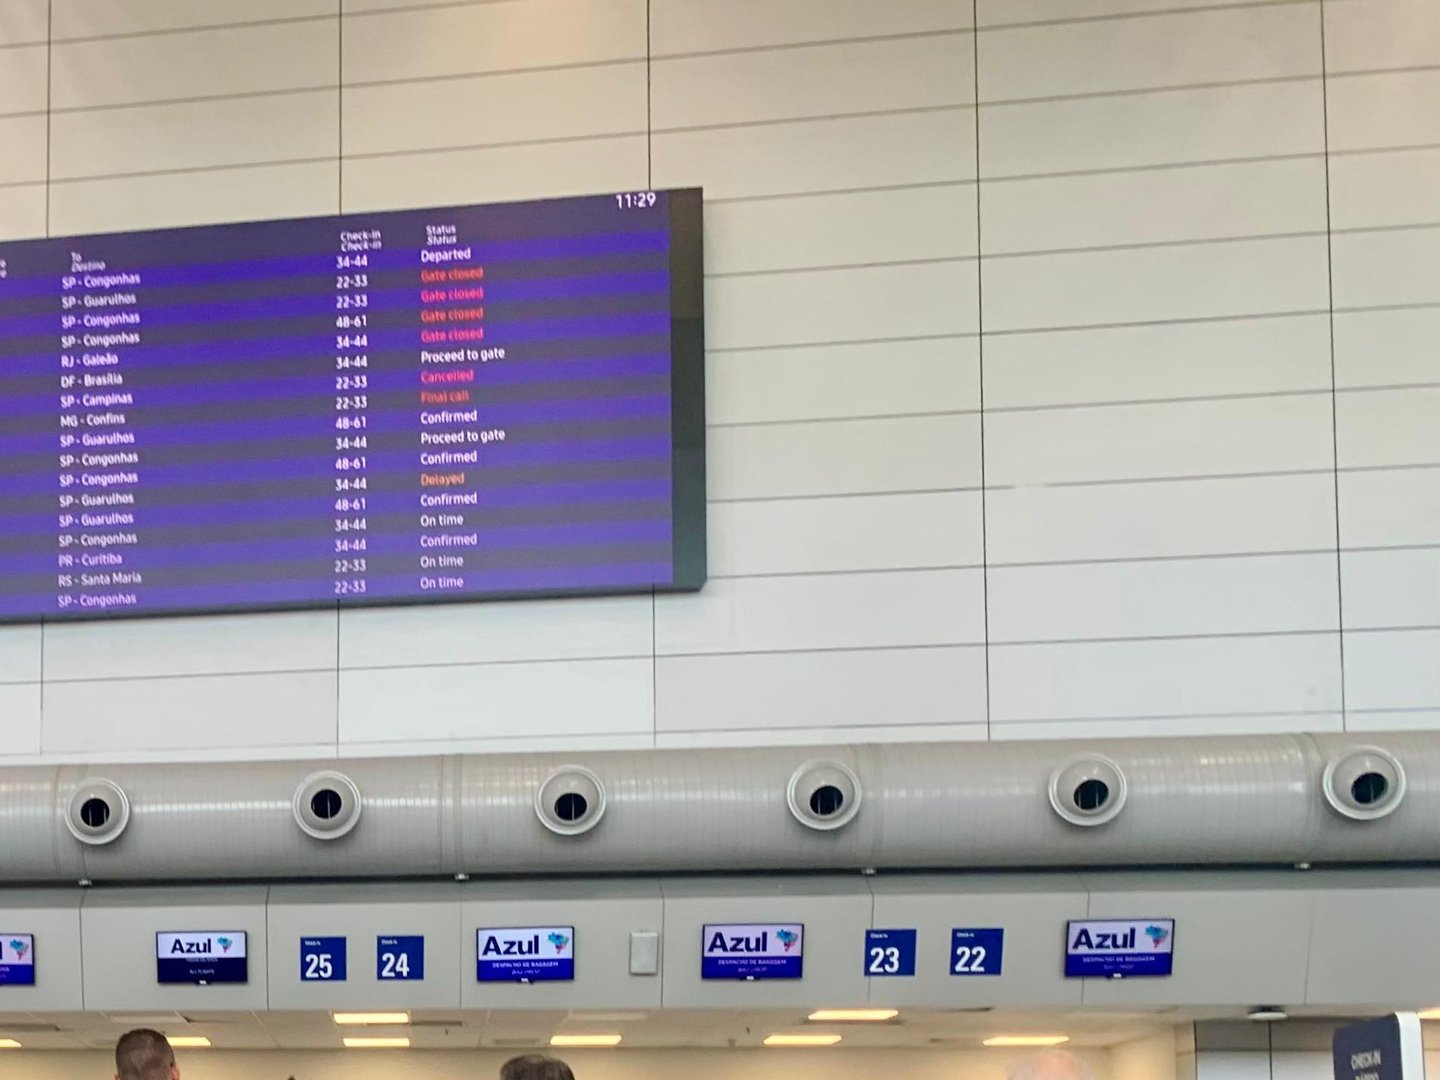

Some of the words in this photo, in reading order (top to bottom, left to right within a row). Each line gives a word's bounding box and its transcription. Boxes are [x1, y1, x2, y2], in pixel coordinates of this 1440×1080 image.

[616, 192, 656, 209] 11:29
[340, 230, 381, 242] Check-in
[426, 225, 456, 236] Status
[341, 241, 382, 252] Check-in
[427, 235, 457, 246] Status
[336, 255, 368, 269] 34-44
[421, 248, 472, 264] Departed
[62, 276, 76, 289] SP
[84, 273, 140, 289] Congonhas
[335, 275, 368, 289] 22-33
[421, 270, 446, 284] Gate
[448, 267, 484, 281] closed
[62, 296, 76, 309] SP
[84, 293, 136, 308] Guarulhos
[335, 296, 368, 309] 22-33
[421, 290, 446, 304] Gate
[448, 287, 484, 301] closed
[62, 316, 76, 329] SP
[84, 312, 140, 328] Congonhas
[335, 316, 368, 328] 48-61
[421, 310, 446, 324] Gate
[448, 307, 484, 321] closed
[61, 336, 76, 348] SP
[84, 332, 140, 348] Congonhas
[335, 335, 367, 349] 34-44
[421, 330, 446, 344] Gate
[448, 327, 484, 340] closed
[61, 355, 74, 368] RJ
[335, 356, 367, 370] 34-44
[421, 350, 464, 364] Proceed
[468, 349, 478, 361] to
[480, 347, 505, 362] gate
[61, 375, 76, 388] DF
[335, 376, 367, 390] 22-33
[420, 369, 474, 384] Cancelled
[60, 395, 75, 408] SP
[82, 392, 133, 408] Campinas
[335, 396, 367, 410] 22-33
[420, 390, 447, 404] Final
[449, 389, 469, 402] call
[60, 415, 78, 428] MG
[87, 413, 126, 426] Confins
[335, 417, 367, 430] 48-61
[420, 410, 478, 425] Confirmed
[60, 434, 74, 448] SP
[82, 432, 134, 446] Guarulhos
[335, 437, 367, 450] 34-44
[420, 430, 464, 445] Proceed
[467, 430, 478, 442] to
[480, 428, 505, 444] gate
[60, 455, 74, 468] SP
[82, 452, 138, 468] Congonhas
[335, 457, 367, 470] 48-61
[420, 450, 478, 466] Confirmed
[60, 474, 74, 488] SP
[82, 472, 138, 488] Congonhas
[335, 478, 367, 492] 34-44
[420, 472, 465, 488] Delayed
[60, 494, 74, 508] SP
[82, 492, 134, 507] Guarulhos
[334, 498, 367, 512] 48-61
[420, 492, 478, 508] Confirmed
[59, 514, 74, 528] SP
[81, 512, 134, 526] Guarulhos
[334, 519, 367, 532] 34-44
[420, 515, 436, 528] On
[438, 514, 464, 527] time
[59, 534, 74, 548] SP
[81, 532, 138, 548] Congonhas
[334, 539, 367, 552] 34-44
[420, 534, 478, 548] Confirmed
[58, 554, 73, 568] PR
[82, 552, 122, 566] Curitiba
[334, 559, 366, 574] 22-33
[420, 556, 436, 568] On
[438, 554, 464, 568] time
[58, 574, 72, 588] RS
[82, 572, 110, 586] Santa
[113, 571, 142, 585] Maria
[334, 580, 366, 594] 22-33
[420, 576, 436, 590] On
[438, 575, 464, 588] time
[58, 594, 73, 608] SP
[80, 592, 136, 608] Congonhas
[171, 938, 212, 954] Azul
[482, 935, 539, 956] Azul
[708, 932, 768, 953] Azul
[1072, 926, 1136, 950] Azul
[306, 954, 332, 978] 25
[381, 952, 410, 978] 24
[869, 946, 900, 974] 23
[955, 946, 986, 973] 22
